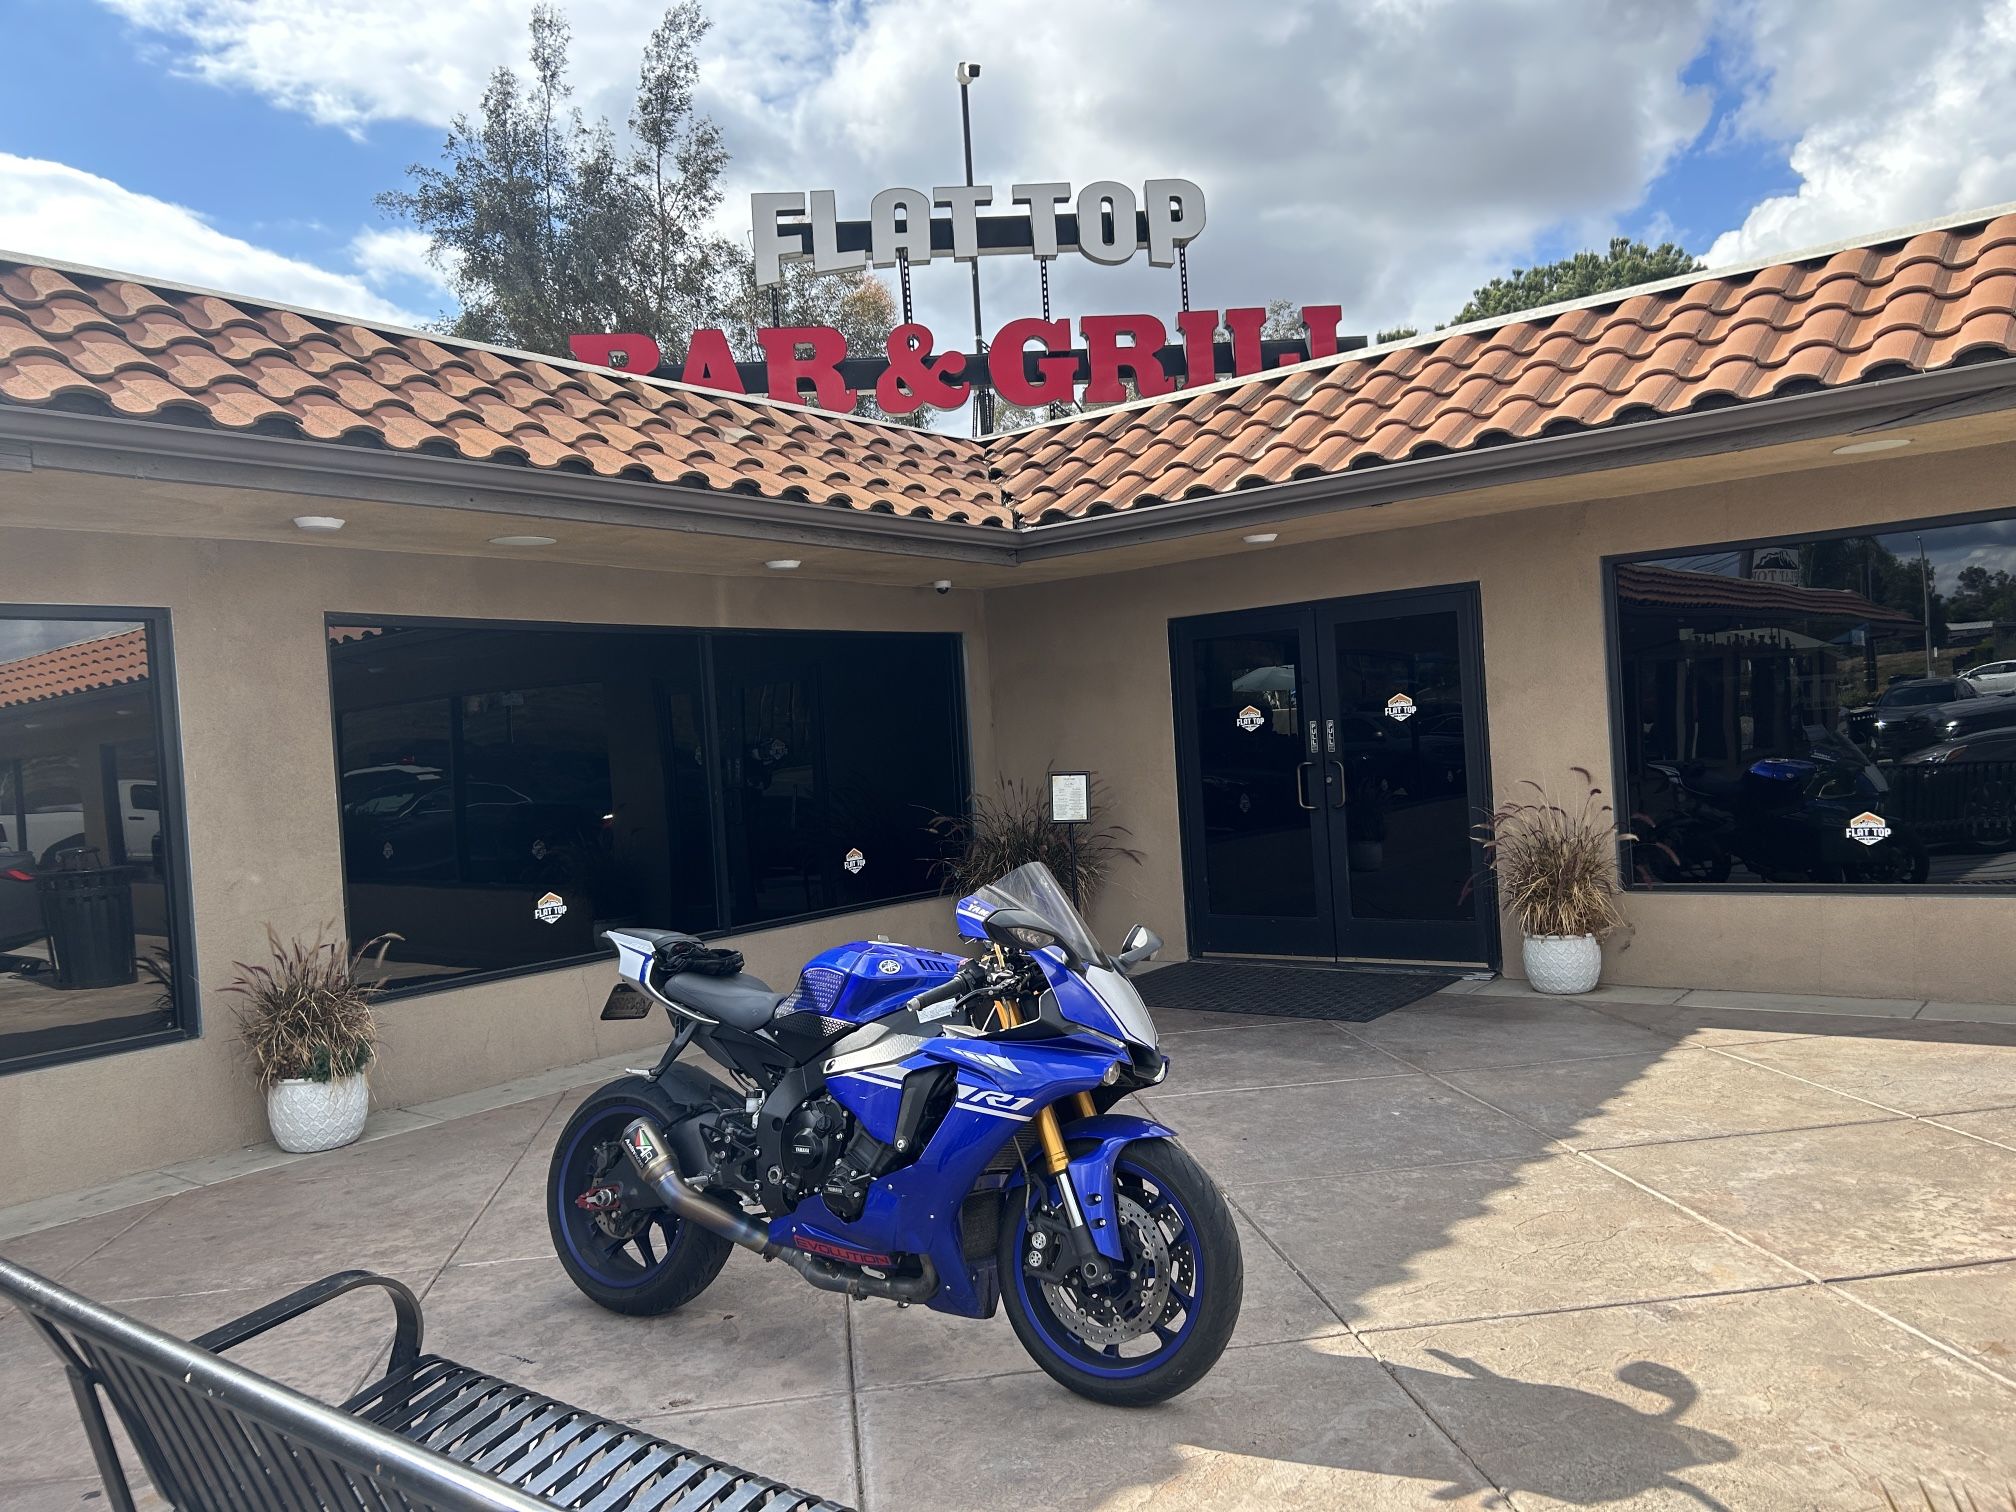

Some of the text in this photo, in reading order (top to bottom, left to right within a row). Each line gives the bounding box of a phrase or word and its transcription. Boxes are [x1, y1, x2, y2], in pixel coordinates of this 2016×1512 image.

[750, 178, 1207, 289] FLAT TOP
[876, 322, 971, 414] &
[1384, 705, 1417, 717] FLAT TOP
[1236, 716, 1265, 727] FLAT TOP
[1845, 827, 1892, 839] FLAT TOP
[534, 907, 552, 920] FLAT
[554, 905, 568, 915] TOP
[968, 1090, 1035, 1111] R1
[795, 1237, 891, 1266] EVOLUTION
